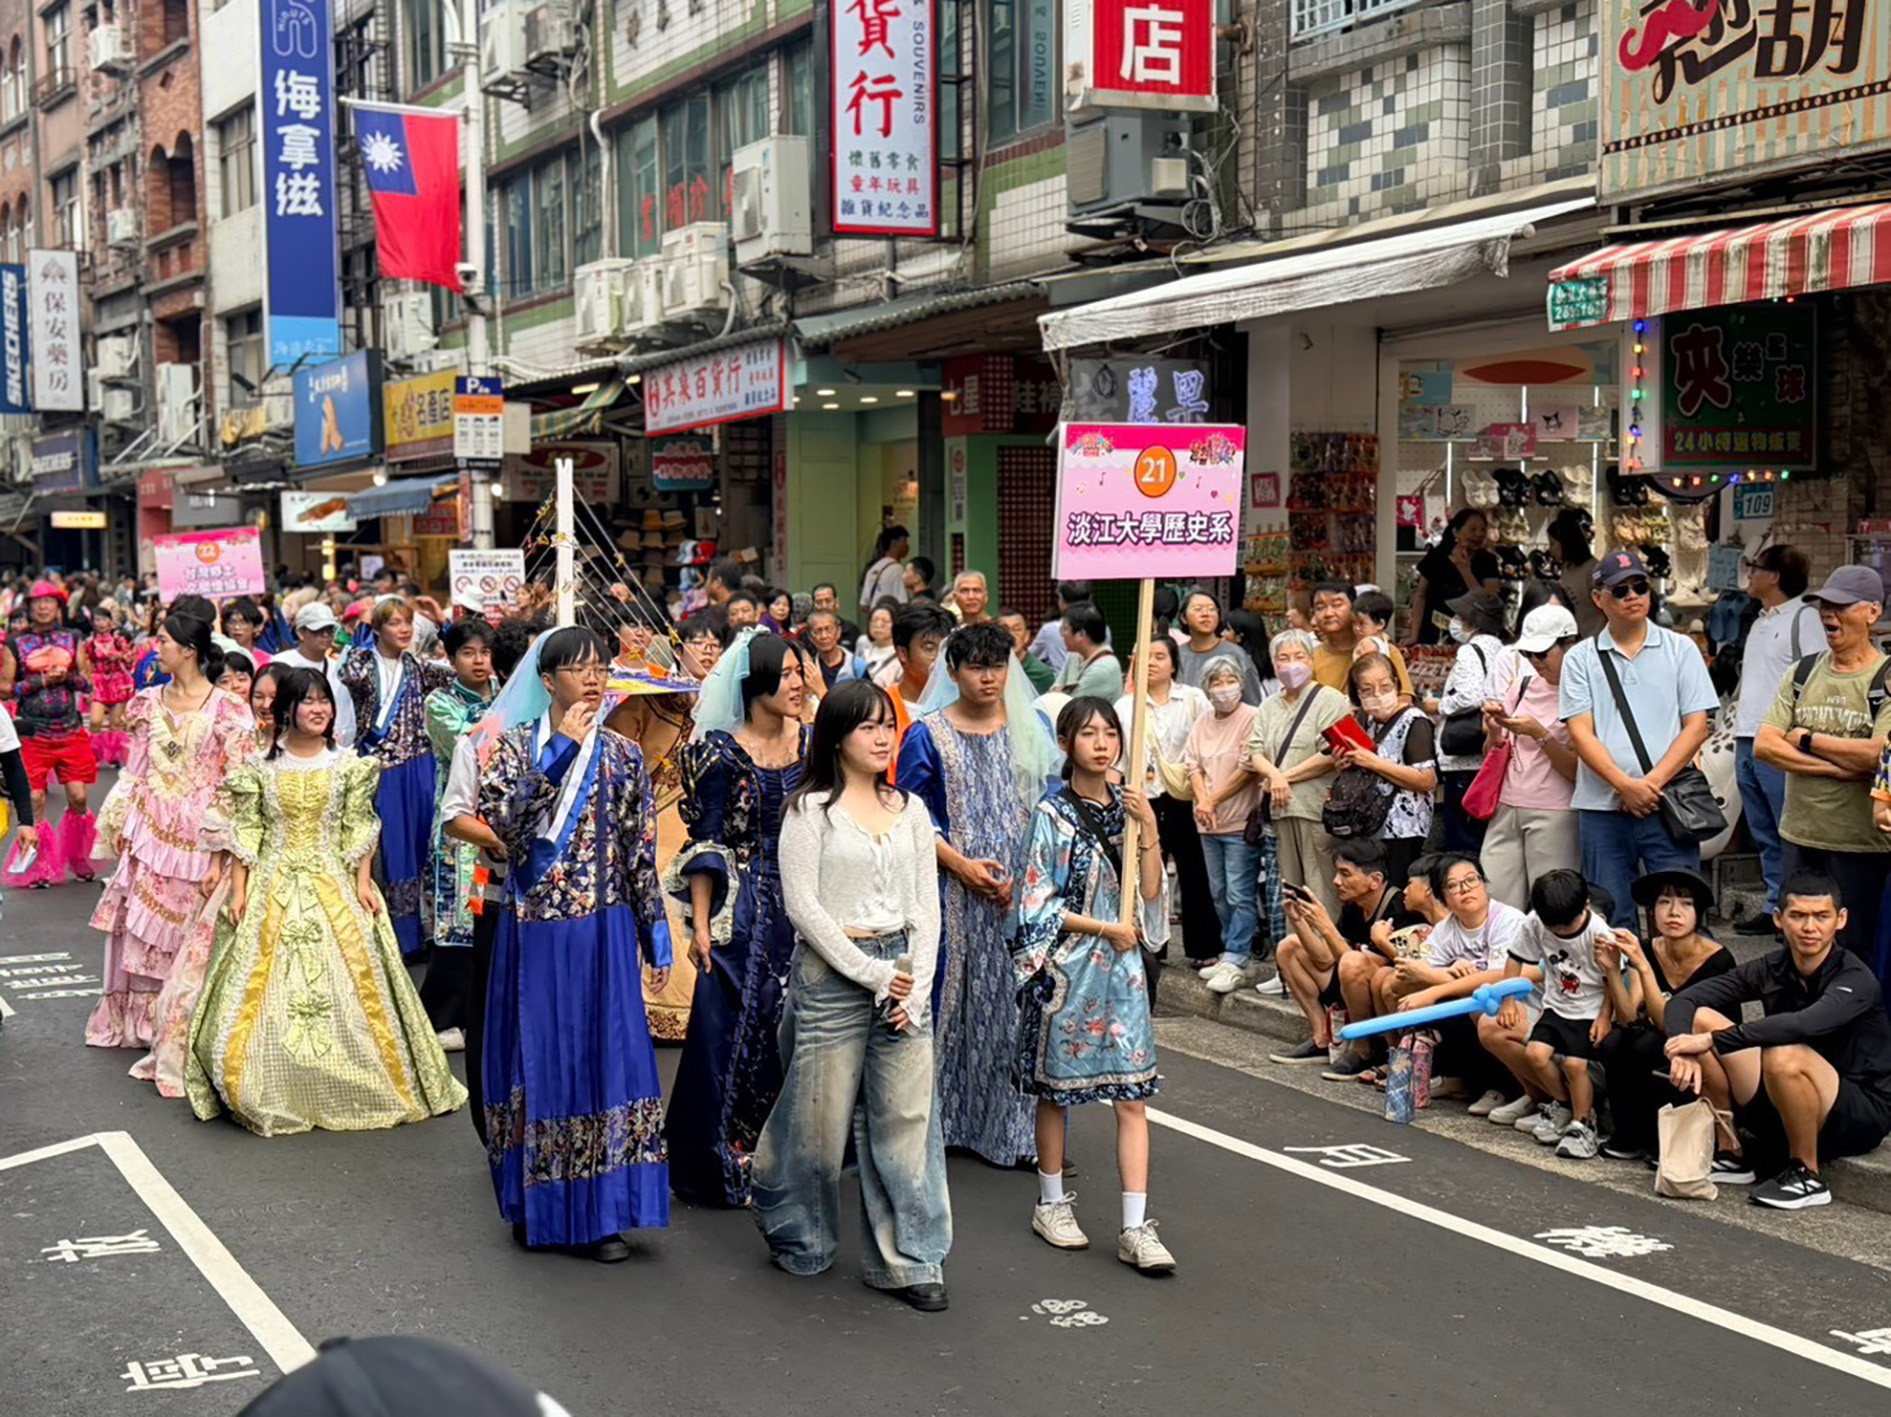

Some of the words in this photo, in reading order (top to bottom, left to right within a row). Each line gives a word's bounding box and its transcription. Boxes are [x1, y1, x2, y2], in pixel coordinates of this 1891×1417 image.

[1120, 3, 1184, 85] 店
[913, 20, 926, 125] SOUVENIRS
[273, 69, 324, 217] 海拿滋
[848, 151, 919, 171] 懷舊零食
[850, 174, 920, 195] 童年玩具
[841, 200, 929, 219] 雜貨紀念品
[2, 270, 23, 407] SKECHERS
[45, 292, 68, 391] 保安藥房
[1141, 457, 1166, 484] 21
[1745, 494, 1771, 515] 109
[1067, 510, 1233, 546] 淡江大學歷史系
[120, 1353, 260, 1392] 停
